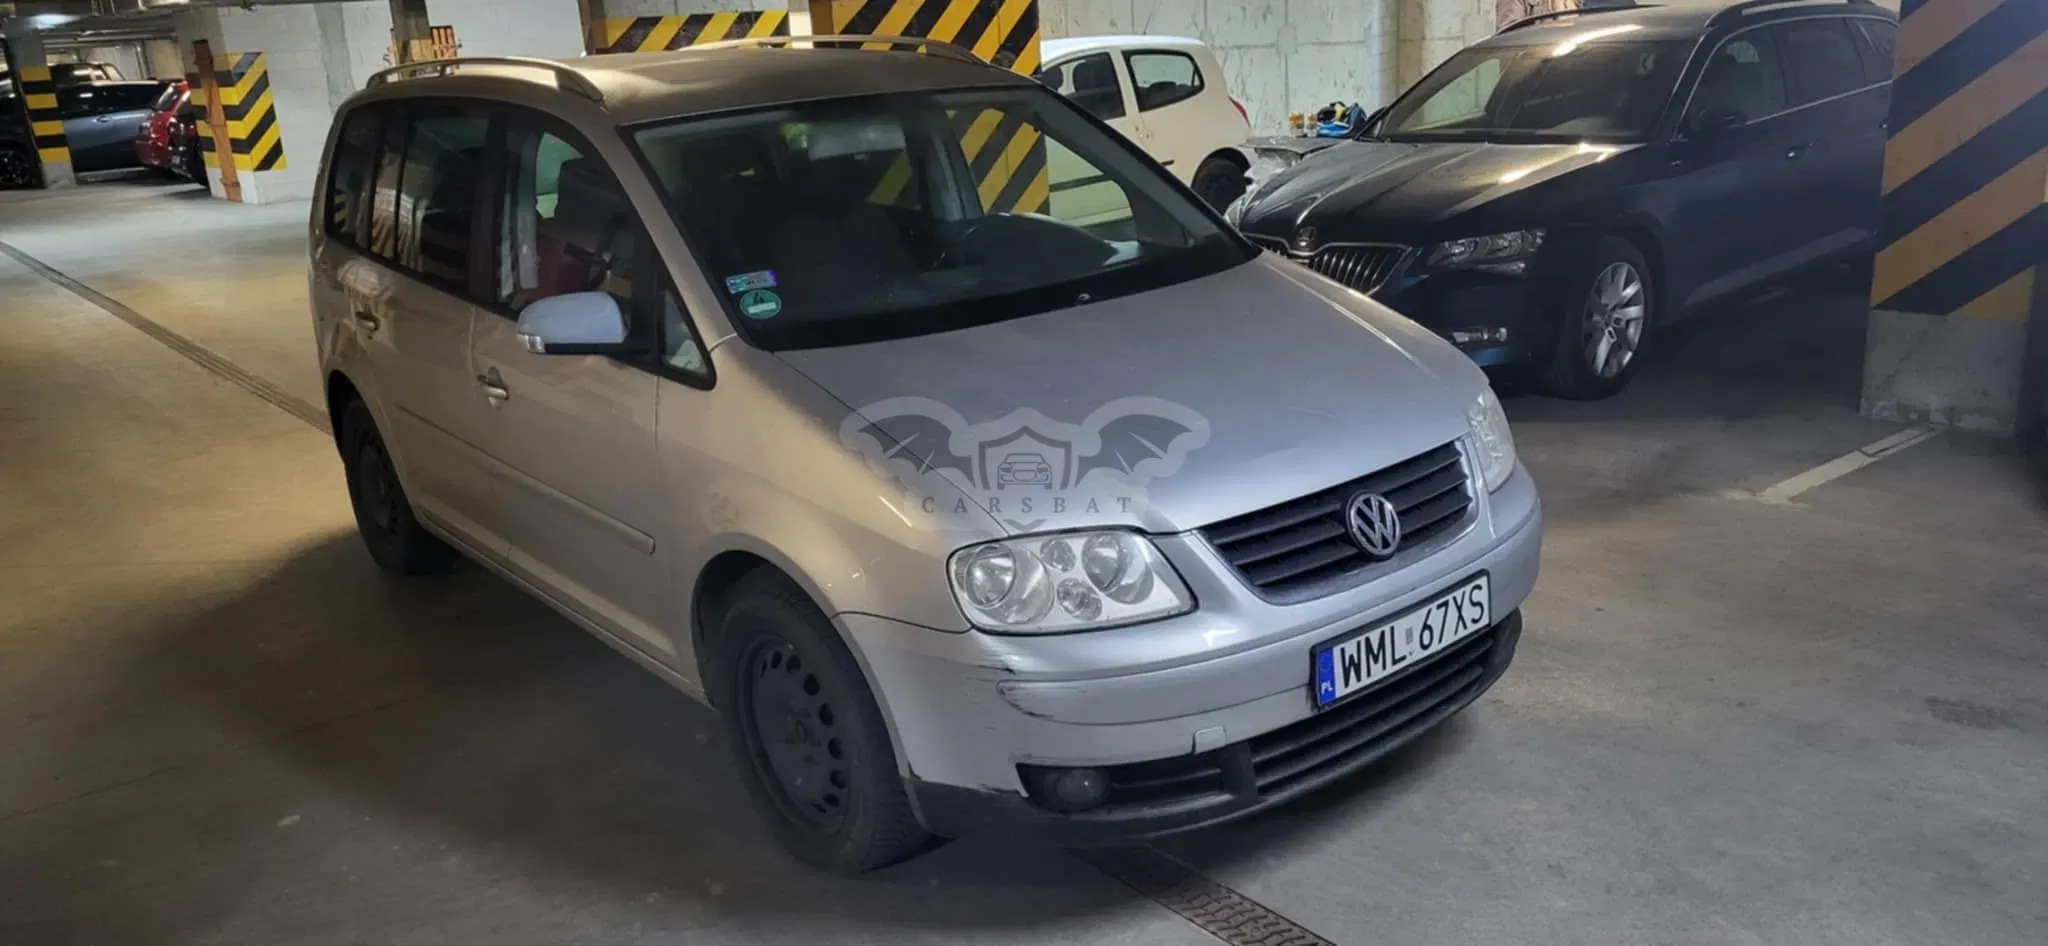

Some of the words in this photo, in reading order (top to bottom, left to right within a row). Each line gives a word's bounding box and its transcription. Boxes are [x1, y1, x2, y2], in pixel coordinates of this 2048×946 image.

[1350, 493, 1400, 555] VW
[1340, 625, 1407, 689] WML
[1419, 584, 1485, 651] 67XS
[1320, 679, 1333, 695] PL
